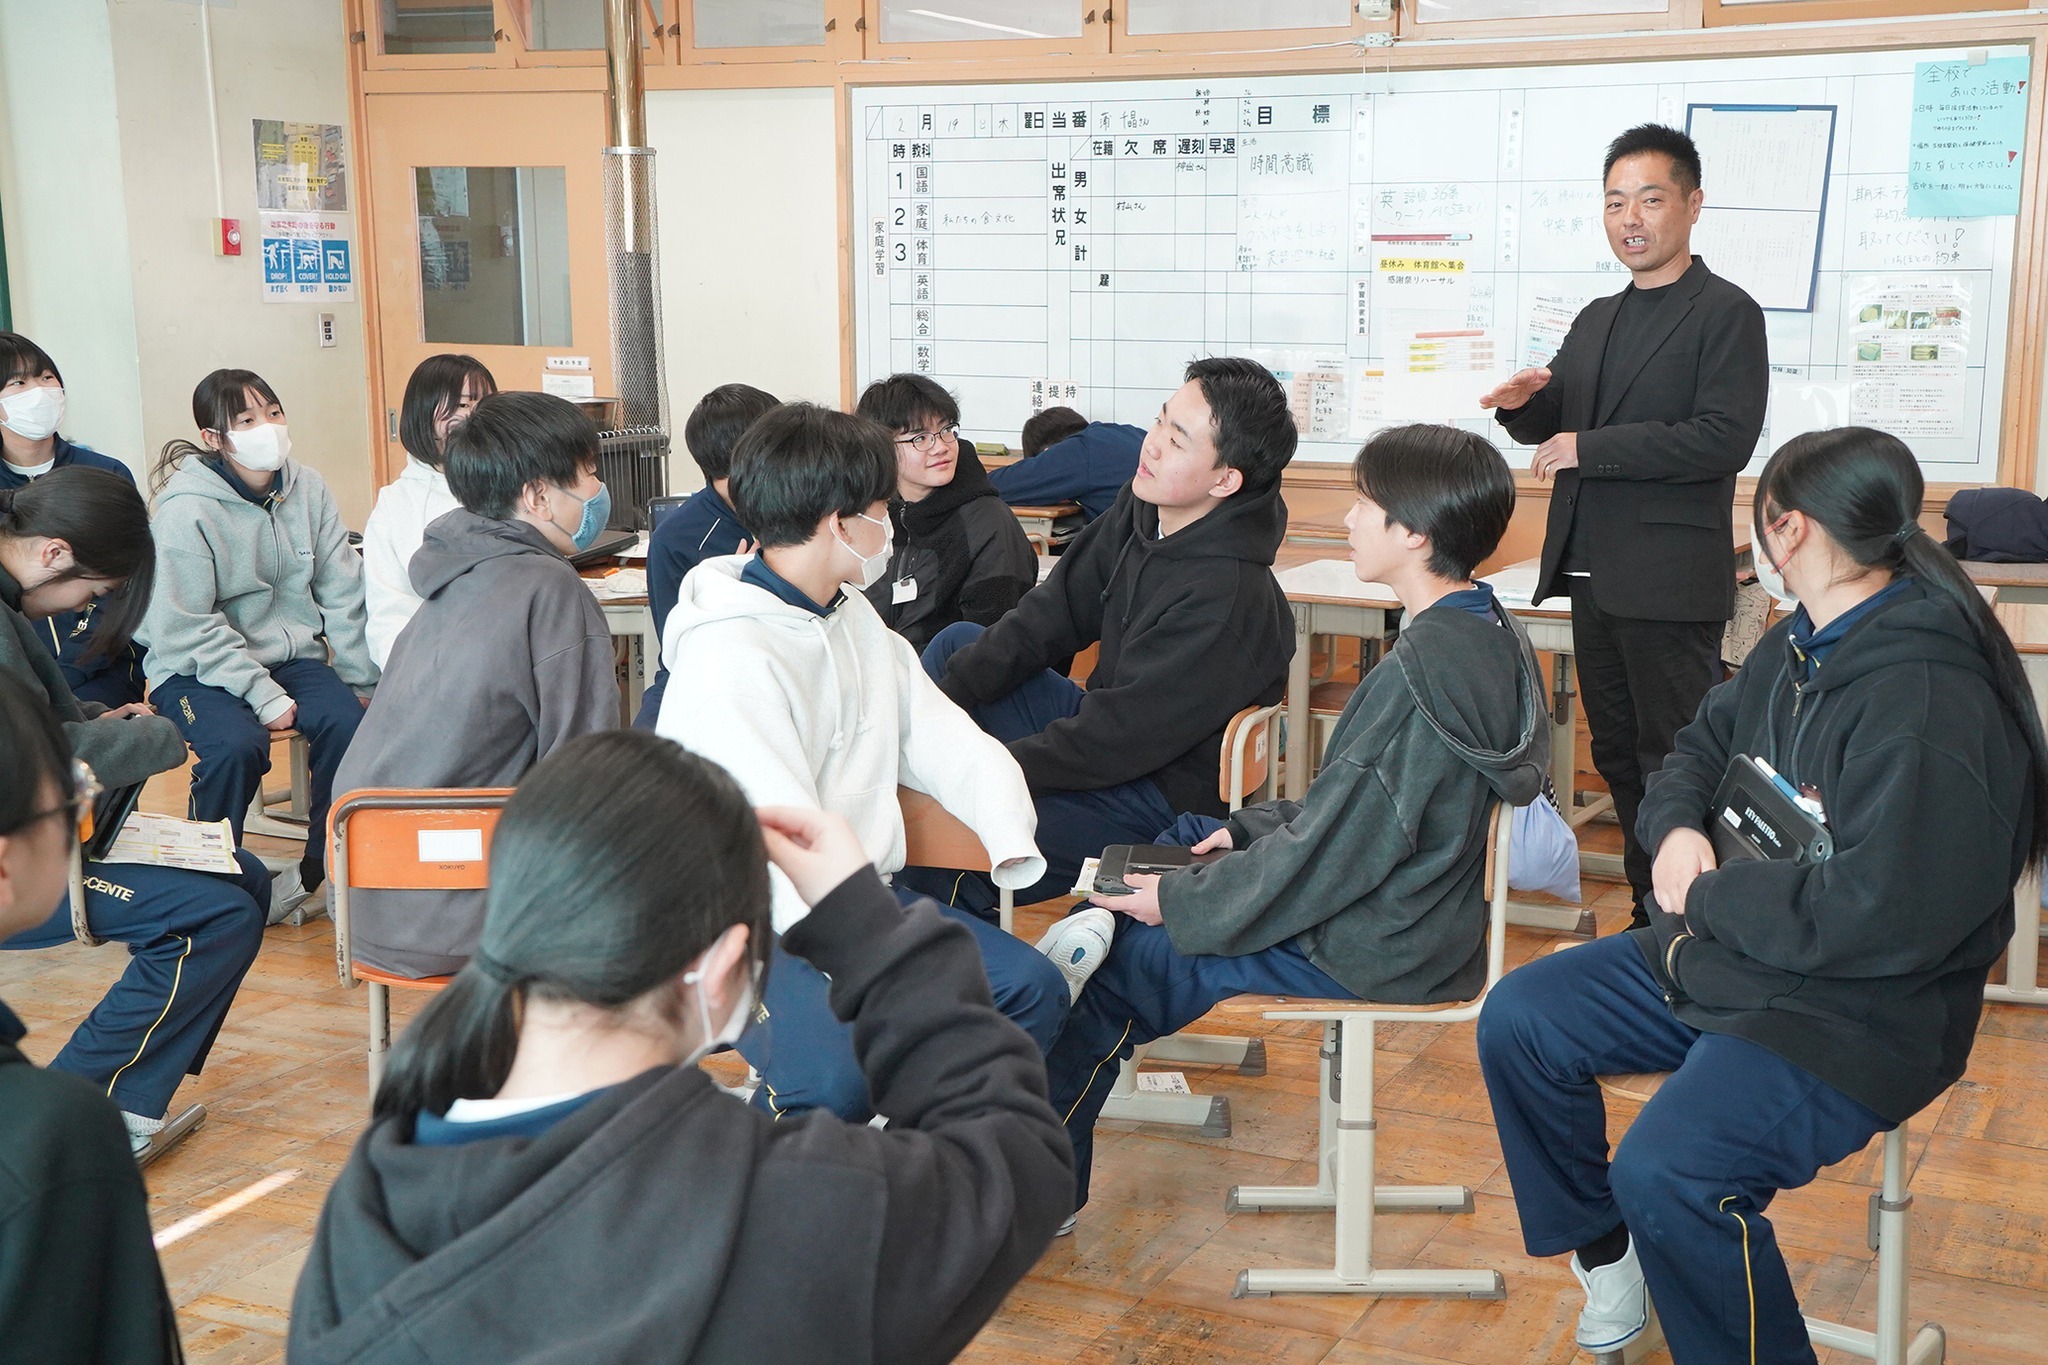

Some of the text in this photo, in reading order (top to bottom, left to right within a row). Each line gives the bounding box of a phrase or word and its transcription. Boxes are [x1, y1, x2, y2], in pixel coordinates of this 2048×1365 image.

[1923, 65, 1971, 83] 全校で
[921, 114, 932, 131] 月
[1052, 110, 1087, 128] 当番
[894, 144, 905, 158] 時
[912, 143, 931, 158] 教科
[1093, 140, 1113, 156] 在籍
[1124, 139, 1167, 155] 欠席
[1178, 138, 1204, 154] 遅刻
[1209, 138, 1236, 154] 早退
[897, 172, 903, 189] 1
[916, 167, 928, 193] 国語
[1075, 171, 1087, 188] 男
[1051, 162, 1066, 246] 出席状況
[895, 208, 905, 225] 2
[916, 204, 928, 230] 家庭
[1075, 208, 1087, 224] 女
[875, 221, 885, 275] 家庭学習
[895, 244, 906, 261] 3
[916, 239, 928, 266] 体育
[1075, 245, 1087, 262] 計
[1380, 259, 1464, 270] 昼休み 体育館へ集合
[298, 272, 318, 281] COVER!
[1387, 275, 1455, 286] 感謝祭リハーサル
[916, 274, 929, 300] 英語
[916, 309, 929, 335] 総合
[917, 345, 930, 371] 数学
